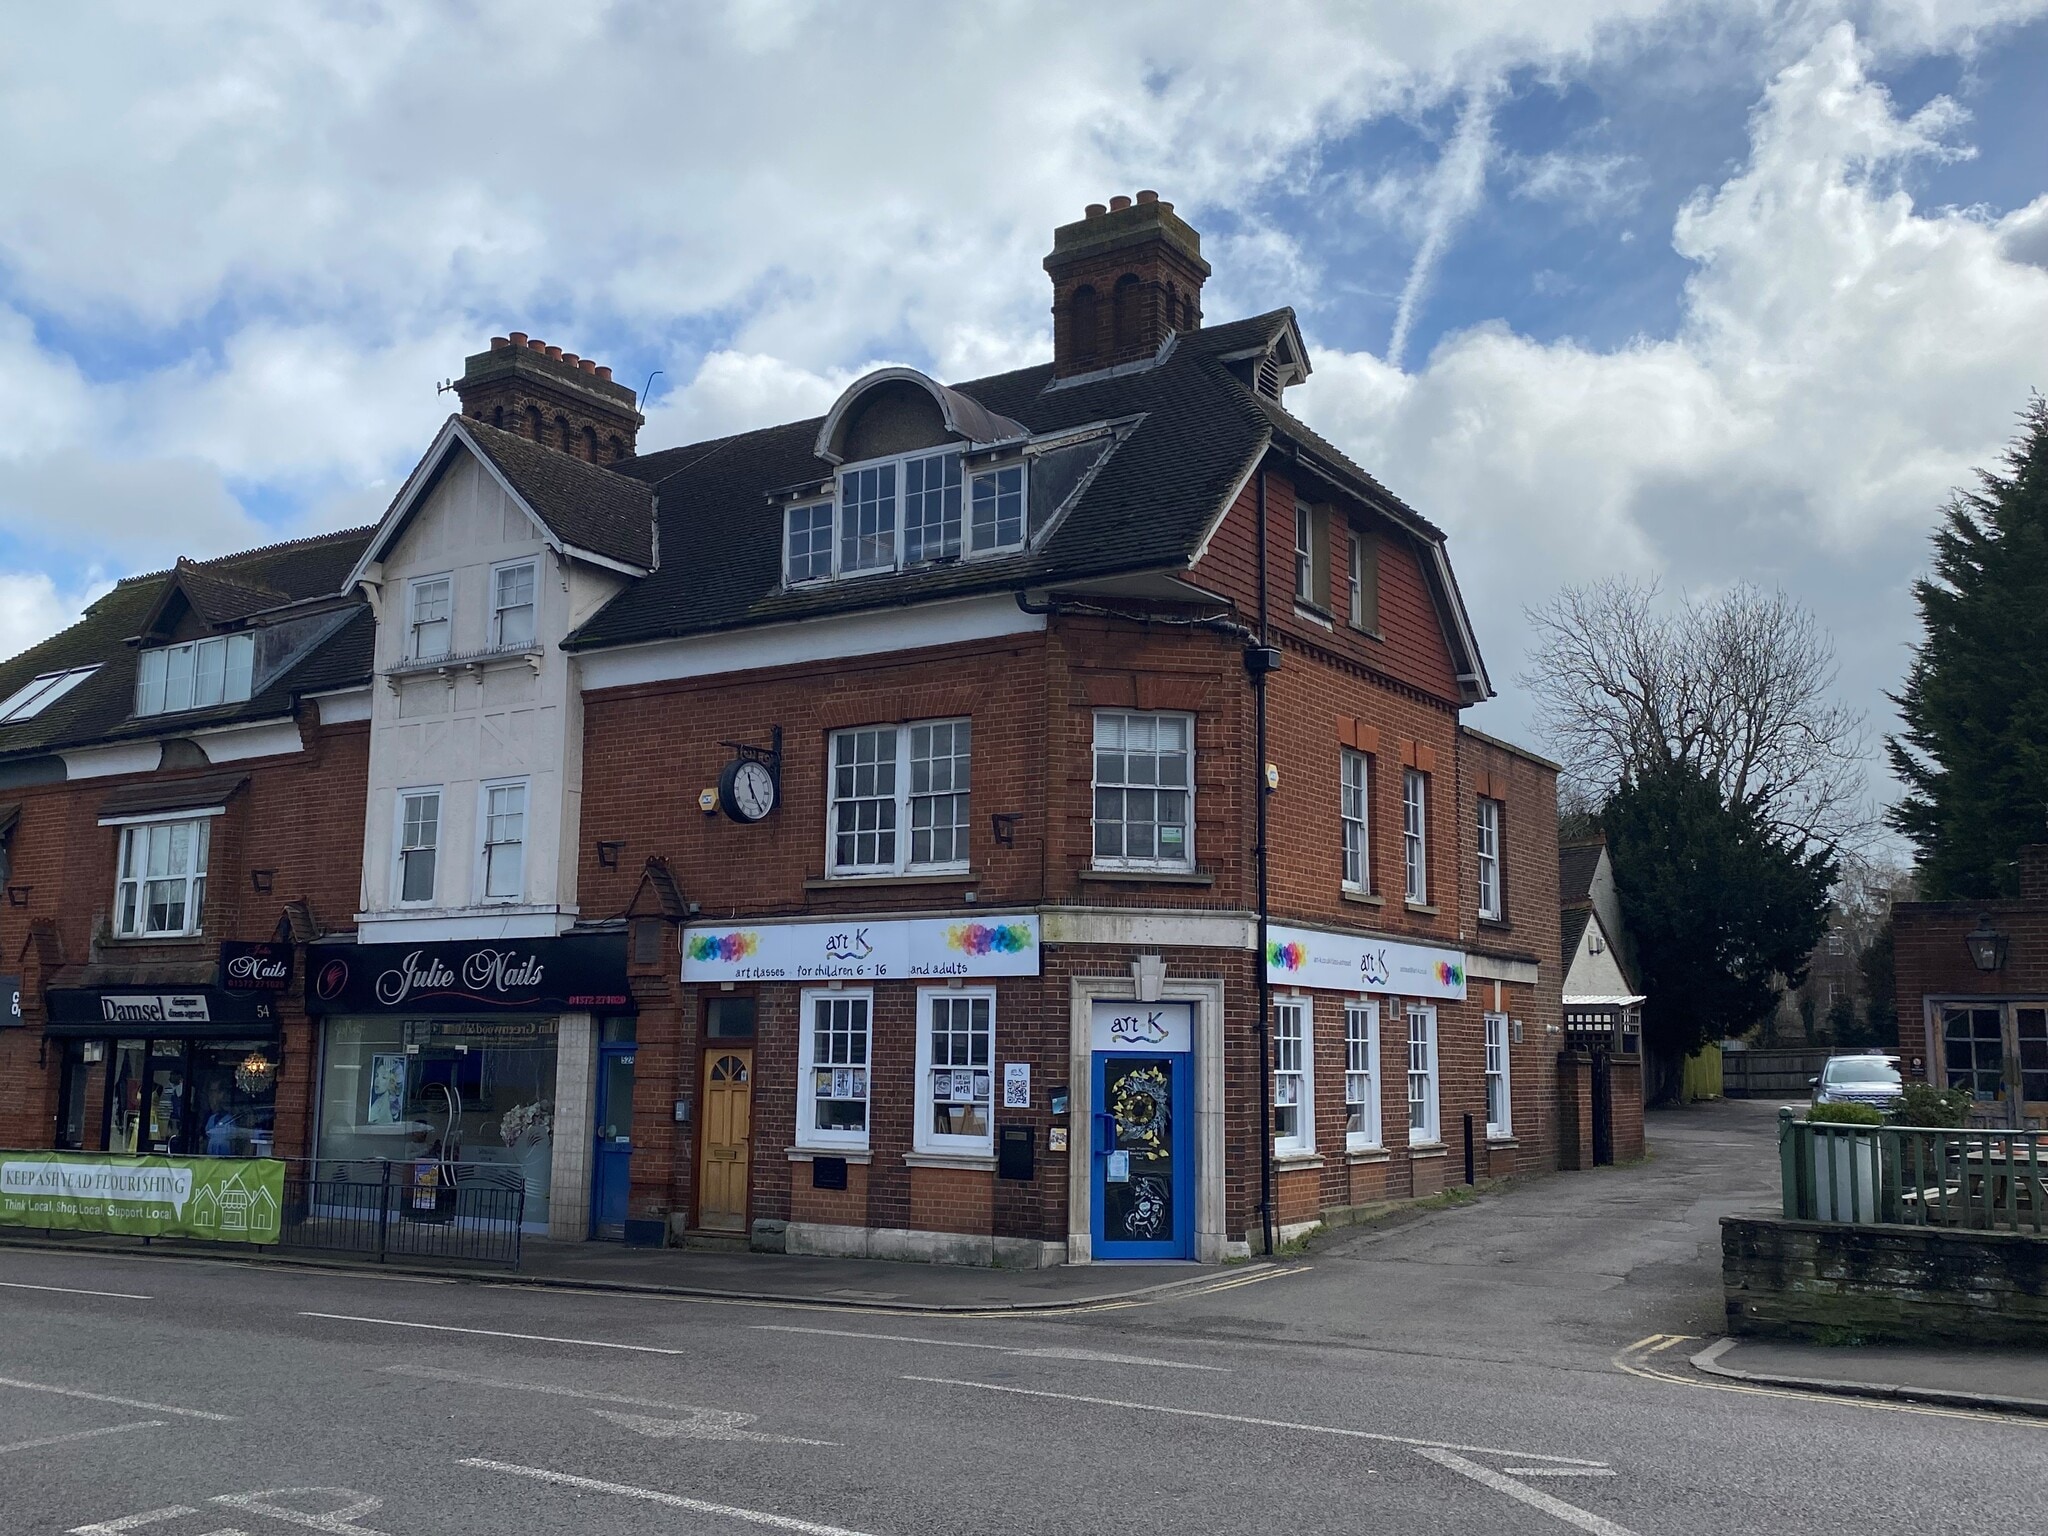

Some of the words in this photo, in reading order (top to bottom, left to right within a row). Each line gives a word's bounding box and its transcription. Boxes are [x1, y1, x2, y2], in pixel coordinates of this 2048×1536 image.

[826, 932, 848, 951] art
[228, 956, 287, 980] Nails
[735, 967, 751, 979] art
[753, 967, 785, 978] classes
[797, 965, 813, 977] for
[814, 963, 854, 977] children
[856, 964, 864, 975] 6
[875, 964, 887, 975] 16
[910, 962, 930, 976] and
[932, 962, 968, 975] adults
[1360, 953, 1375, 972] art
[376, 950, 455, 1005] Julie
[462, 948, 544, 992] Nails
[102, 996, 166, 1021] Damsel
[256, 1004, 269, 1019] 54
[1111, 1016, 1139, 1033] art
[6, 1170, 34, 1186] KEEP
[96, 1174, 186, 1194] FLOURISHING
[5, 1199, 26, 1211] Think
[28, 1199, 54, 1213] Local,
[56, 1201, 78, 1217] Shop
[79, 1203, 104, 1217] Local,
[106, 1204, 143, 1219] Support
[146, 1206, 172, 1221] Local
